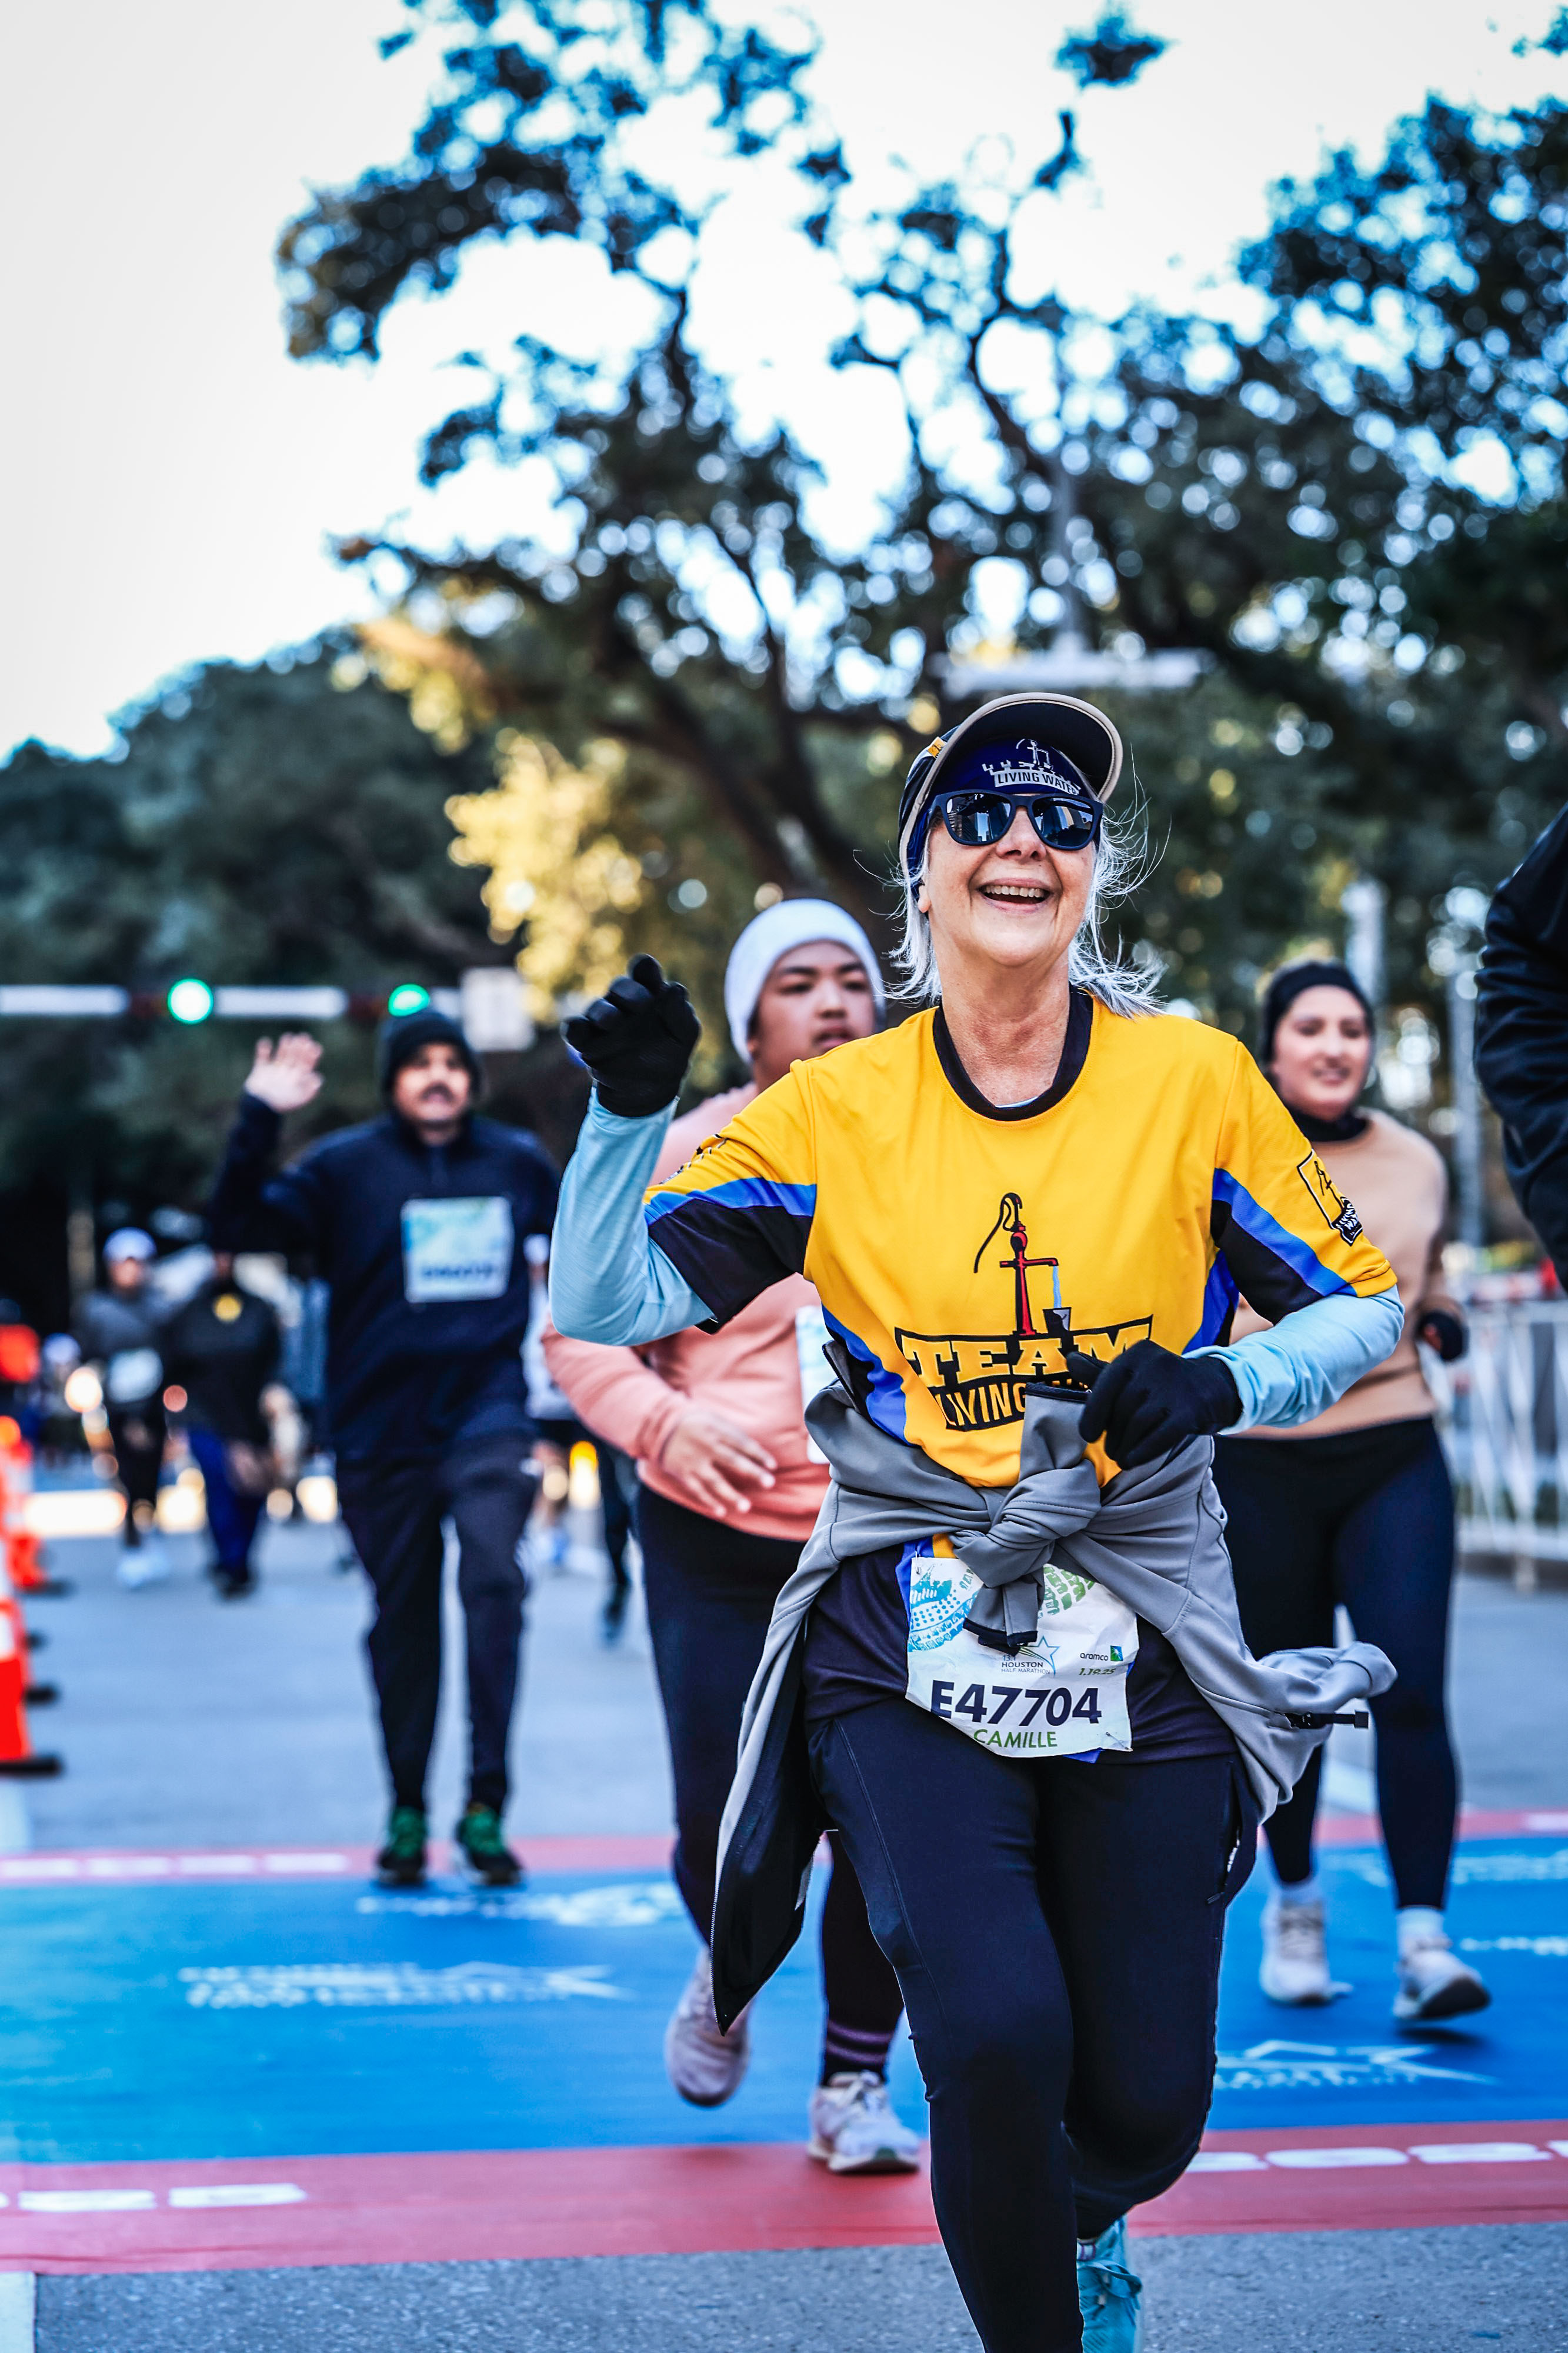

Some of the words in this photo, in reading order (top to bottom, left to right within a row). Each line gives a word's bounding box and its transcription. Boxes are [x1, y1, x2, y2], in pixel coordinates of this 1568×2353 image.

[997, 772, 1040, 784] LIVING
[901, 1323, 1152, 1388] TEAM
[1080, 1652, 1109, 1661] aramco
[931, 1679, 1102, 1727] E47704
[973, 1728, 1057, 1748] CAMILLE
